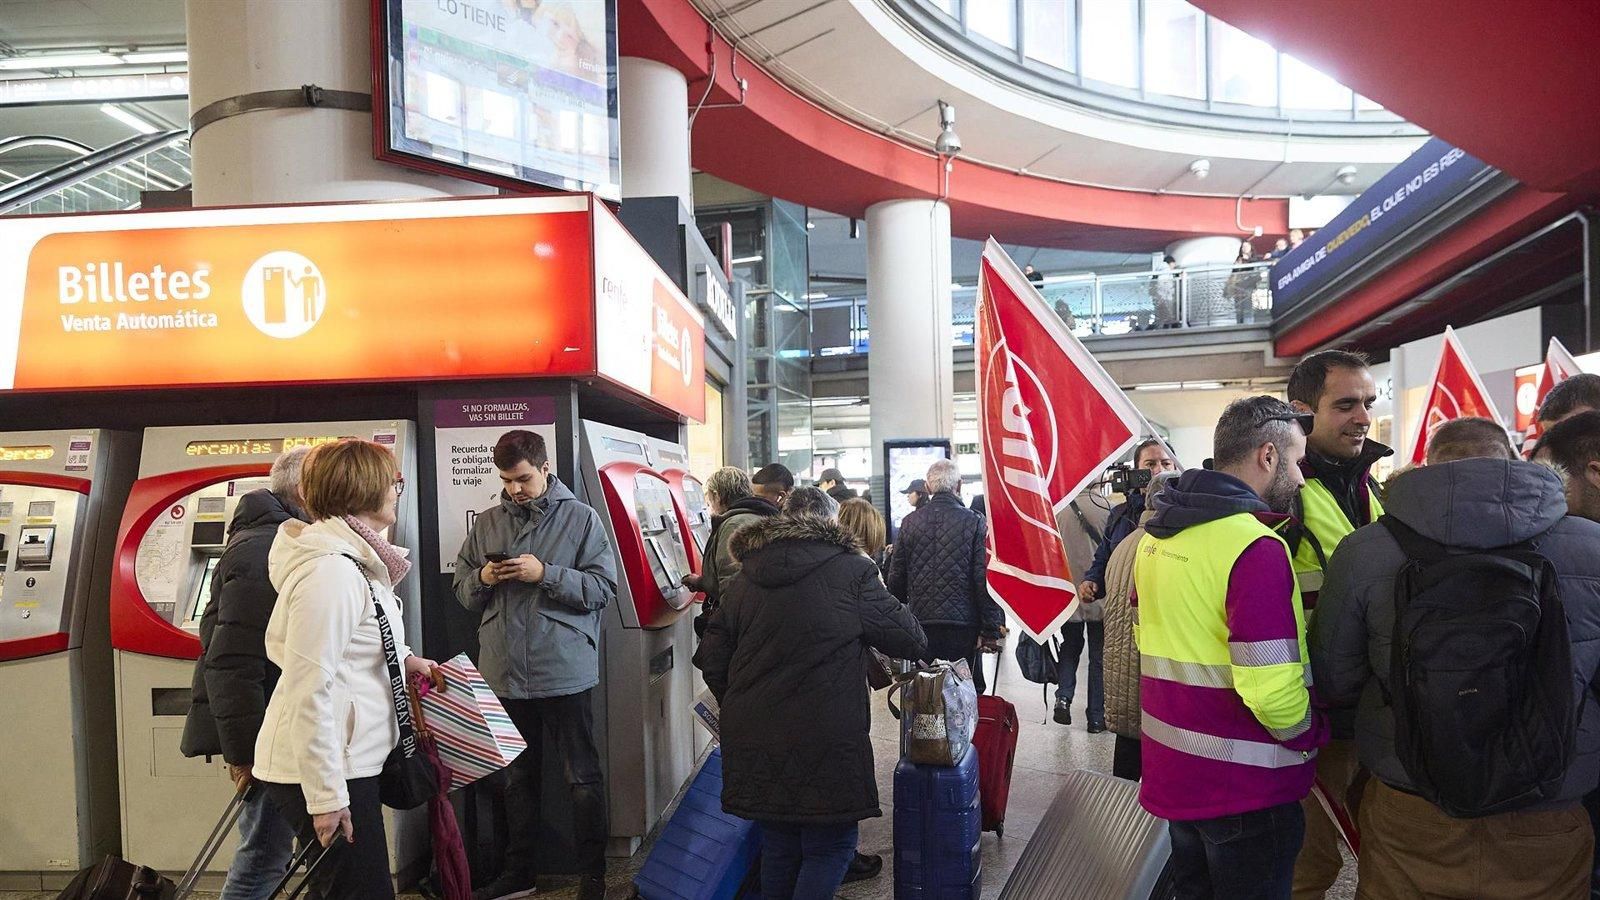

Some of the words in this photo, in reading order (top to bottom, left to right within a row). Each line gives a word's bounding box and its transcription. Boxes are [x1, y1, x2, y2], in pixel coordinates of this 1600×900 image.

[437, 0, 458, 15] LO
[460, 2, 506, 33] TIENE
[1315, 246, 1327, 263] DE
[1370, 205, 1384, 222] EL
[1383, 187, 1407, 212] QUE
[1405, 175, 1423, 196] NO
[1422, 162, 1440, 183] ES
[58, 262, 211, 304] Billetes
[61, 315, 111, 332] Venta
[116, 310, 218, 330] Automática
[462, 404, 470, 413] SI
[471, 404, 482, 412] NO
[484, 402, 530, 412] FORMALIZAS,
[469, 413, 482, 421] VAS
[484, 413, 496, 421] SIN
[498, 412, 524, 420] BILLETE
[451, 444, 488, 454] Recuerda
[452, 466, 492, 475] formalizar
[463, 476, 482, 487] viaje
[379, 613, 399, 667] BIMBAY
[391, 675, 410, 727] BIMBAY
